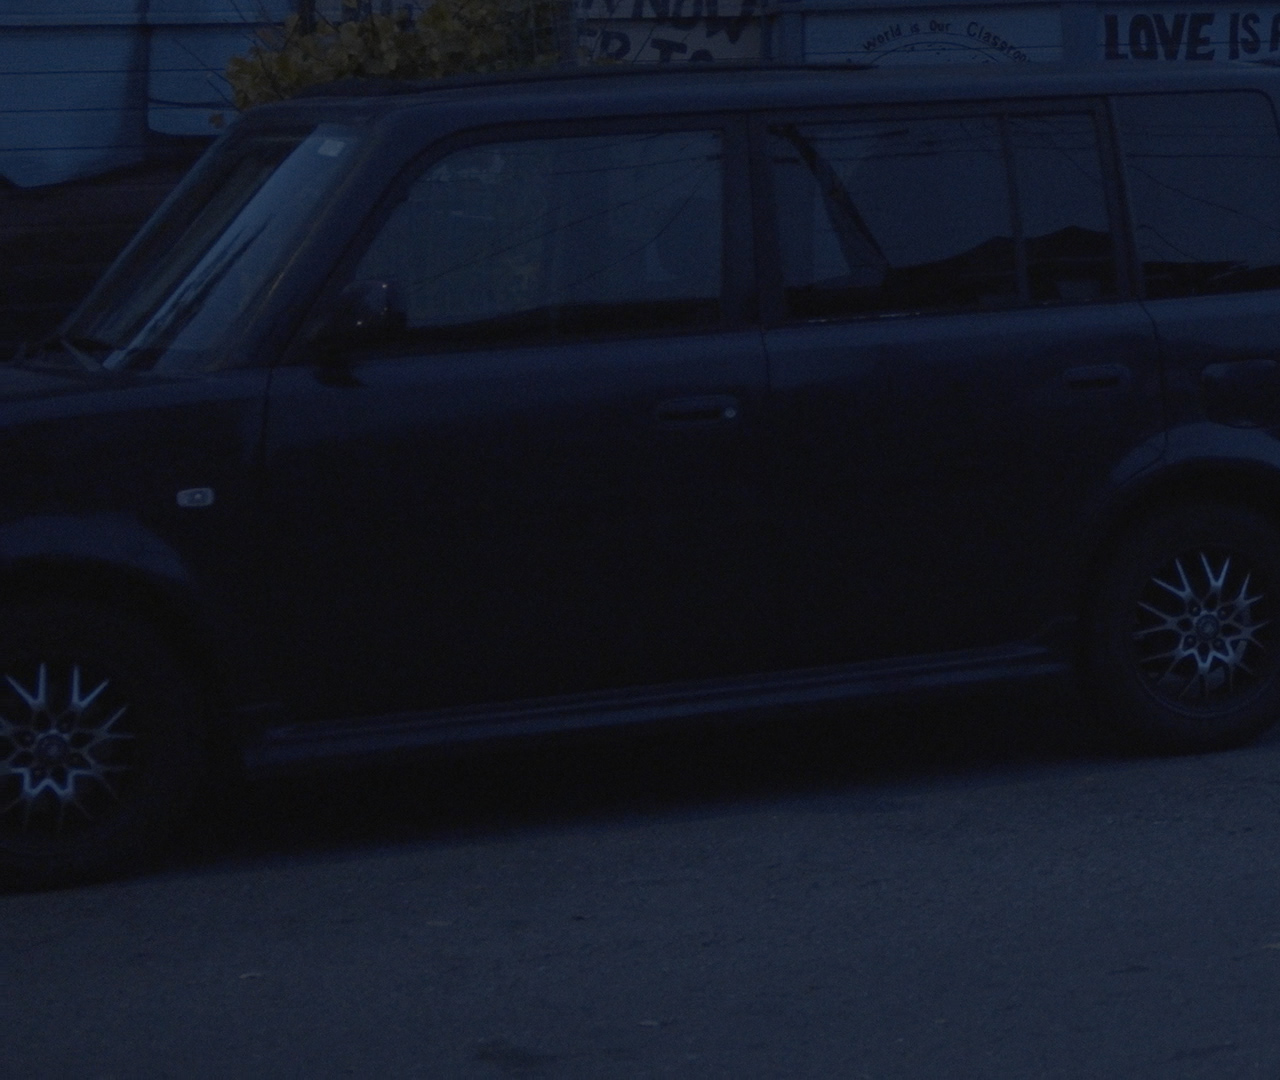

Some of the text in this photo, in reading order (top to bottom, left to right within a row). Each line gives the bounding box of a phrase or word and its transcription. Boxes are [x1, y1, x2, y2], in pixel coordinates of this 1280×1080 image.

[910, 22, 920, 34] is
[929, 19, 952, 32] Our
[966, 21, 1031, 63] Classroo
[1103, 12, 1216, 62] LOVE
[1228, 11, 1262, 60] IS
